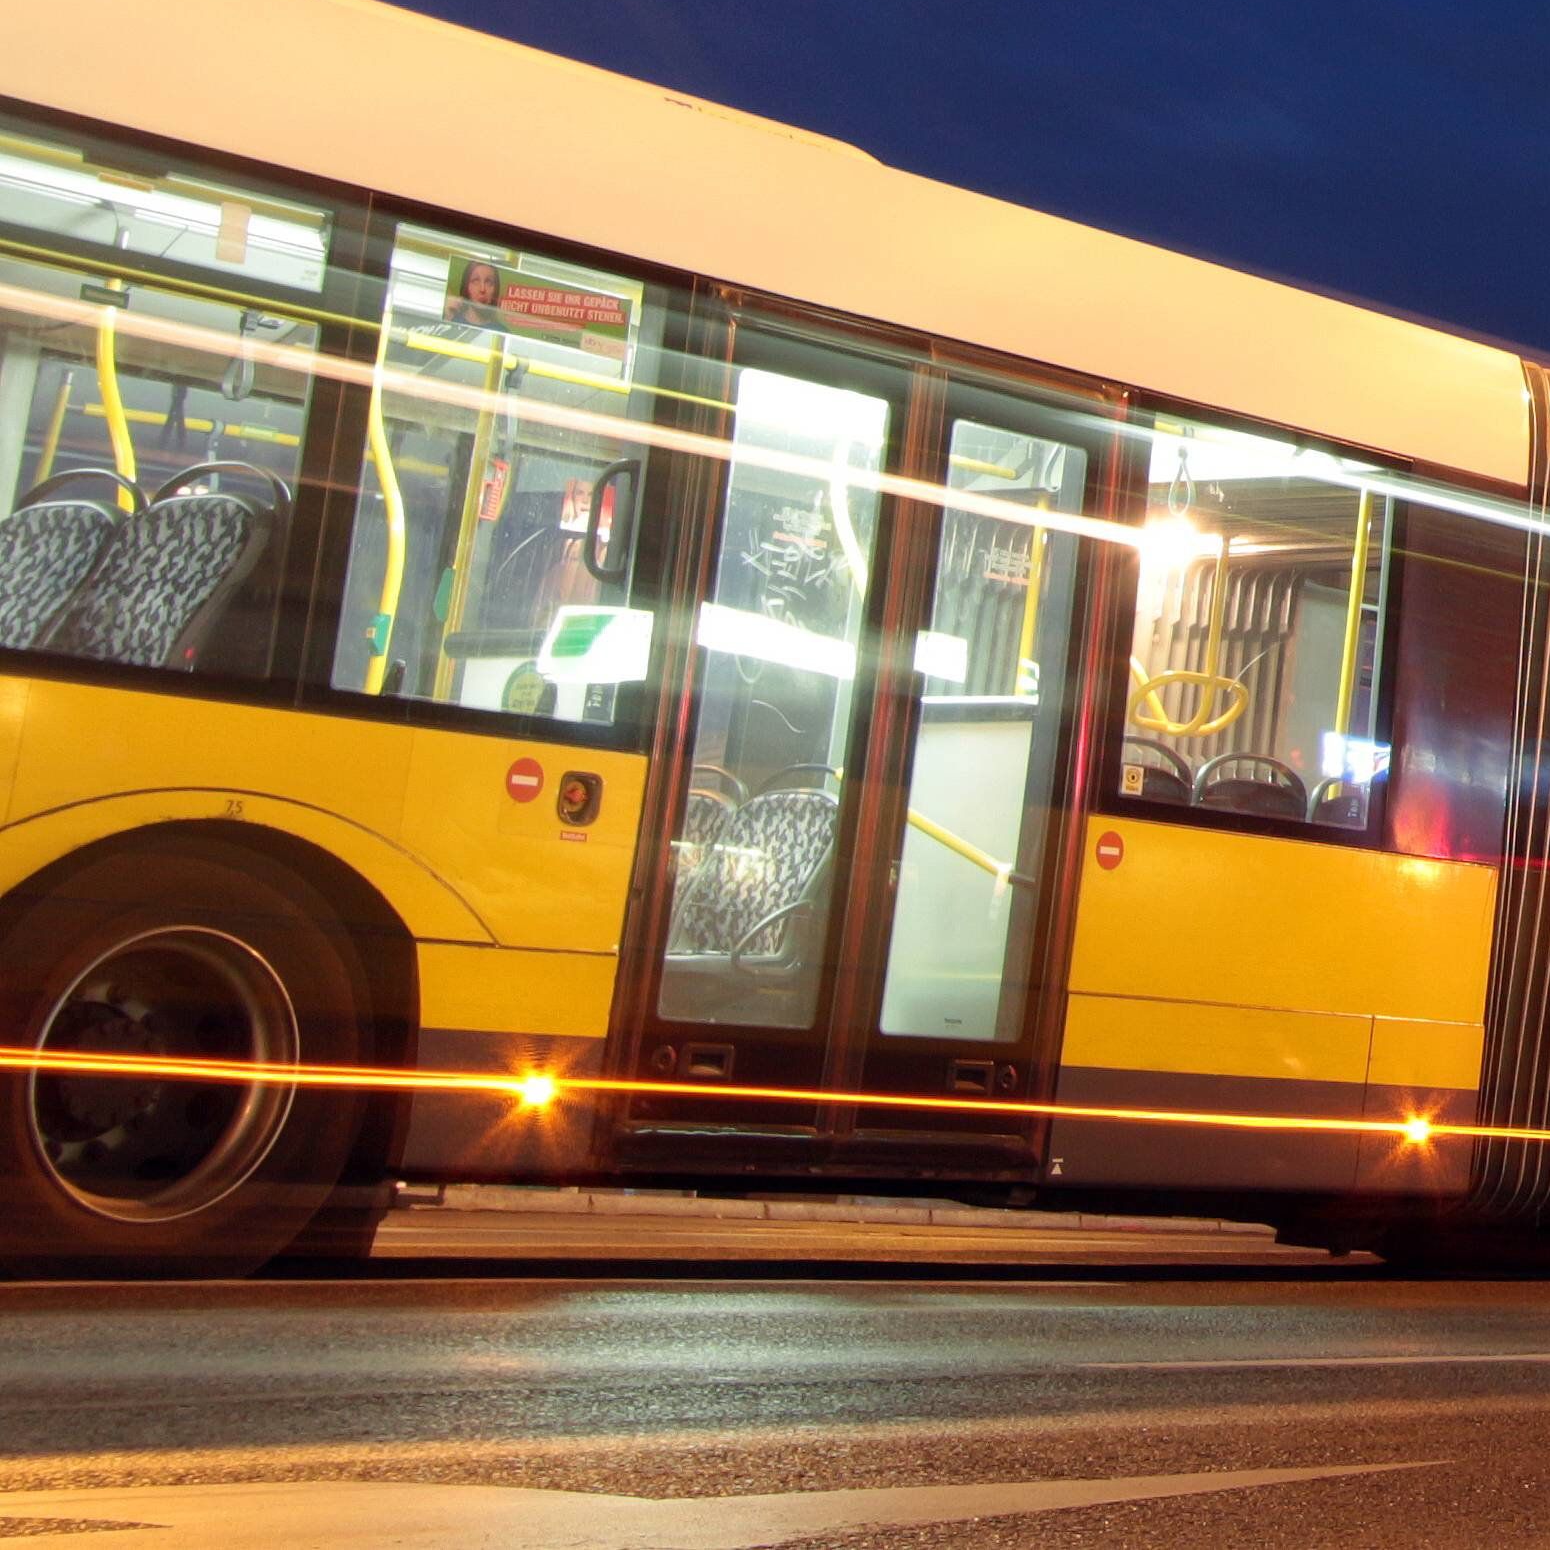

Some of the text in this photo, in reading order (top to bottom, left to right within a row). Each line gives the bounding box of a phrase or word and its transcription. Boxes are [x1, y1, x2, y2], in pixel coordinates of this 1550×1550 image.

[508, 286, 620, 310] LASSEN SIE IHR GEPÄCK
[501, 300, 529, 313] NICHT
[531, 303, 585, 319] UNBENUTZT
